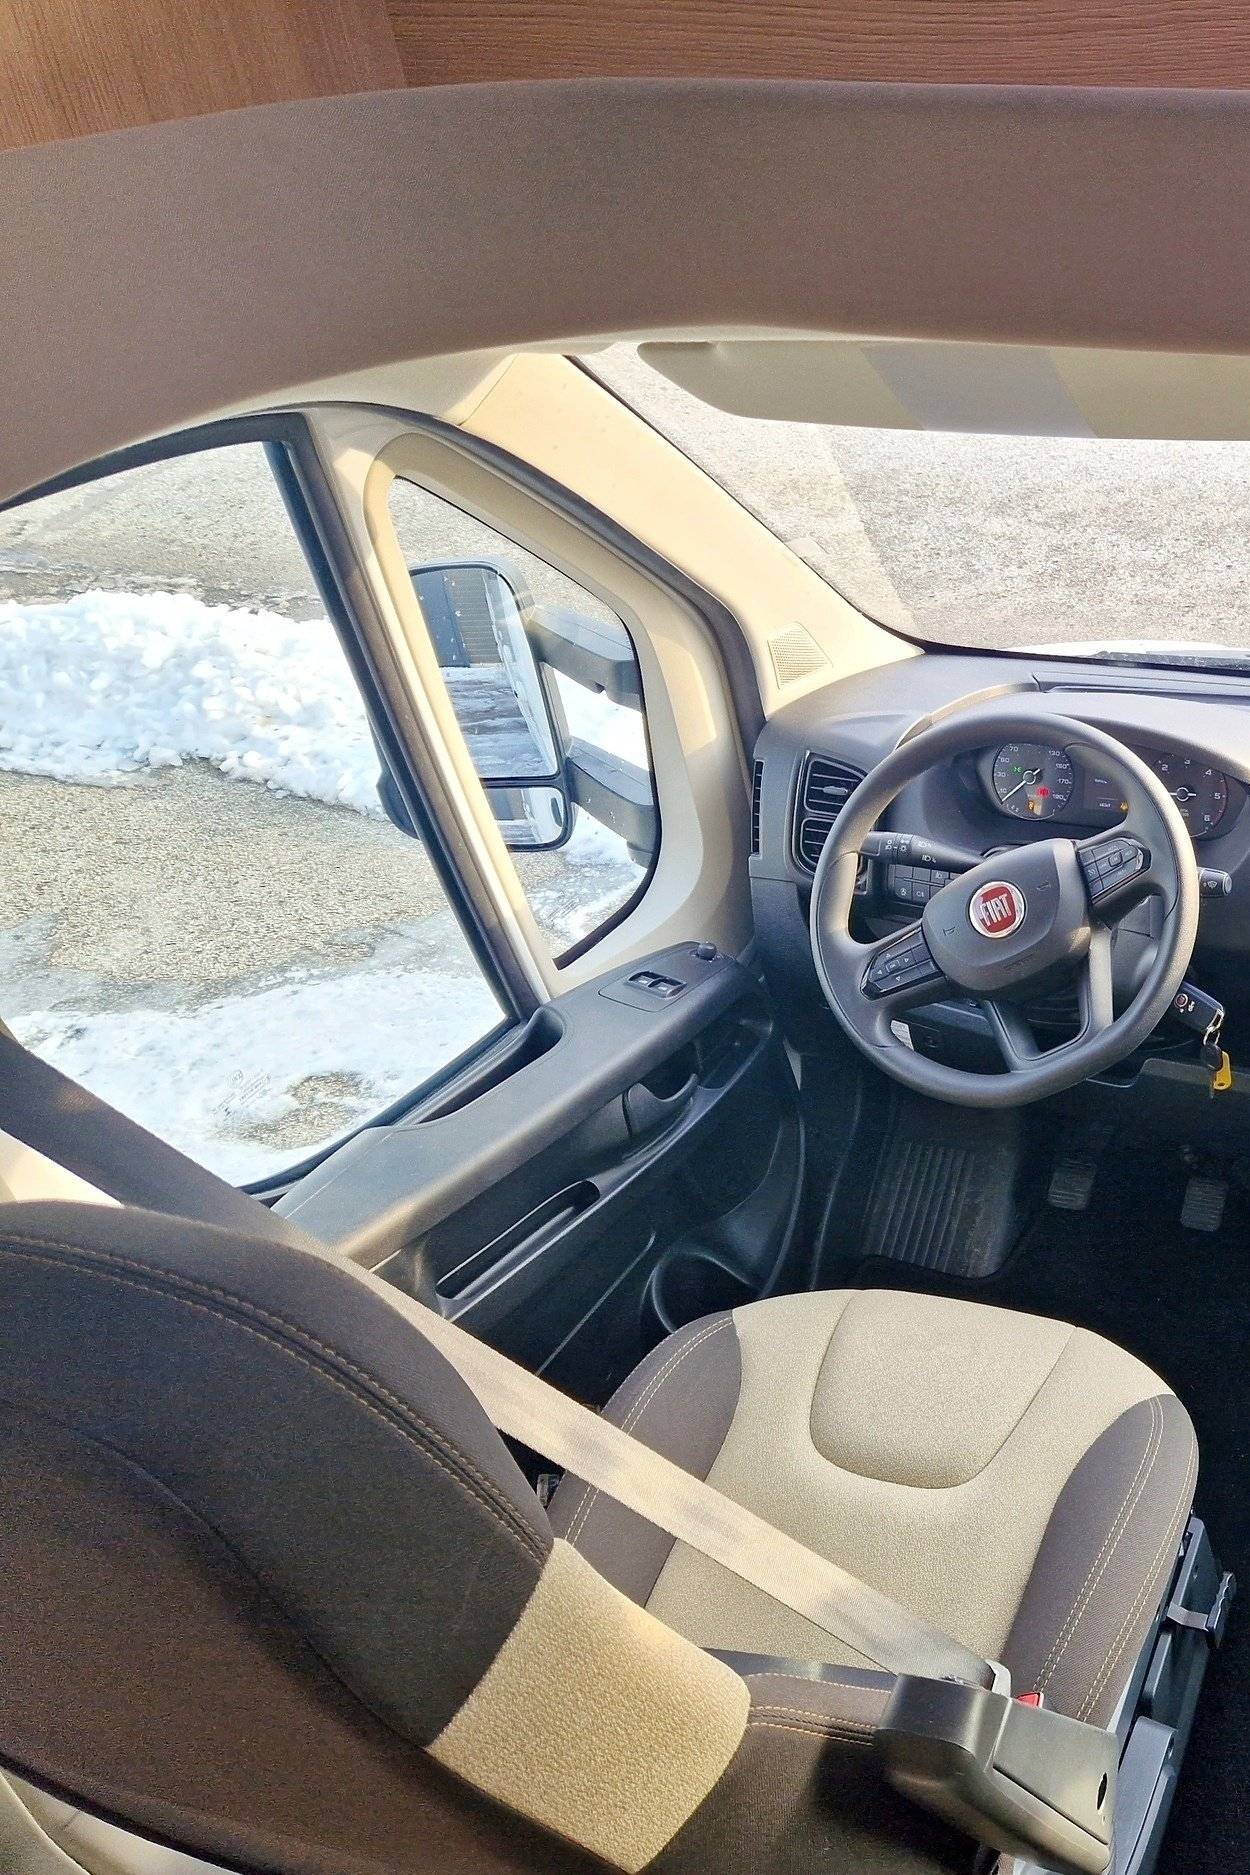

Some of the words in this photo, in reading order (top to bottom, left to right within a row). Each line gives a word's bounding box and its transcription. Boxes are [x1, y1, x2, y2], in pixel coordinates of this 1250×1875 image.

[1214, 792, 1221, 800] 5
[1204, 814, 1211, 822] 6
[979, 893, 1012, 927] FIAT
